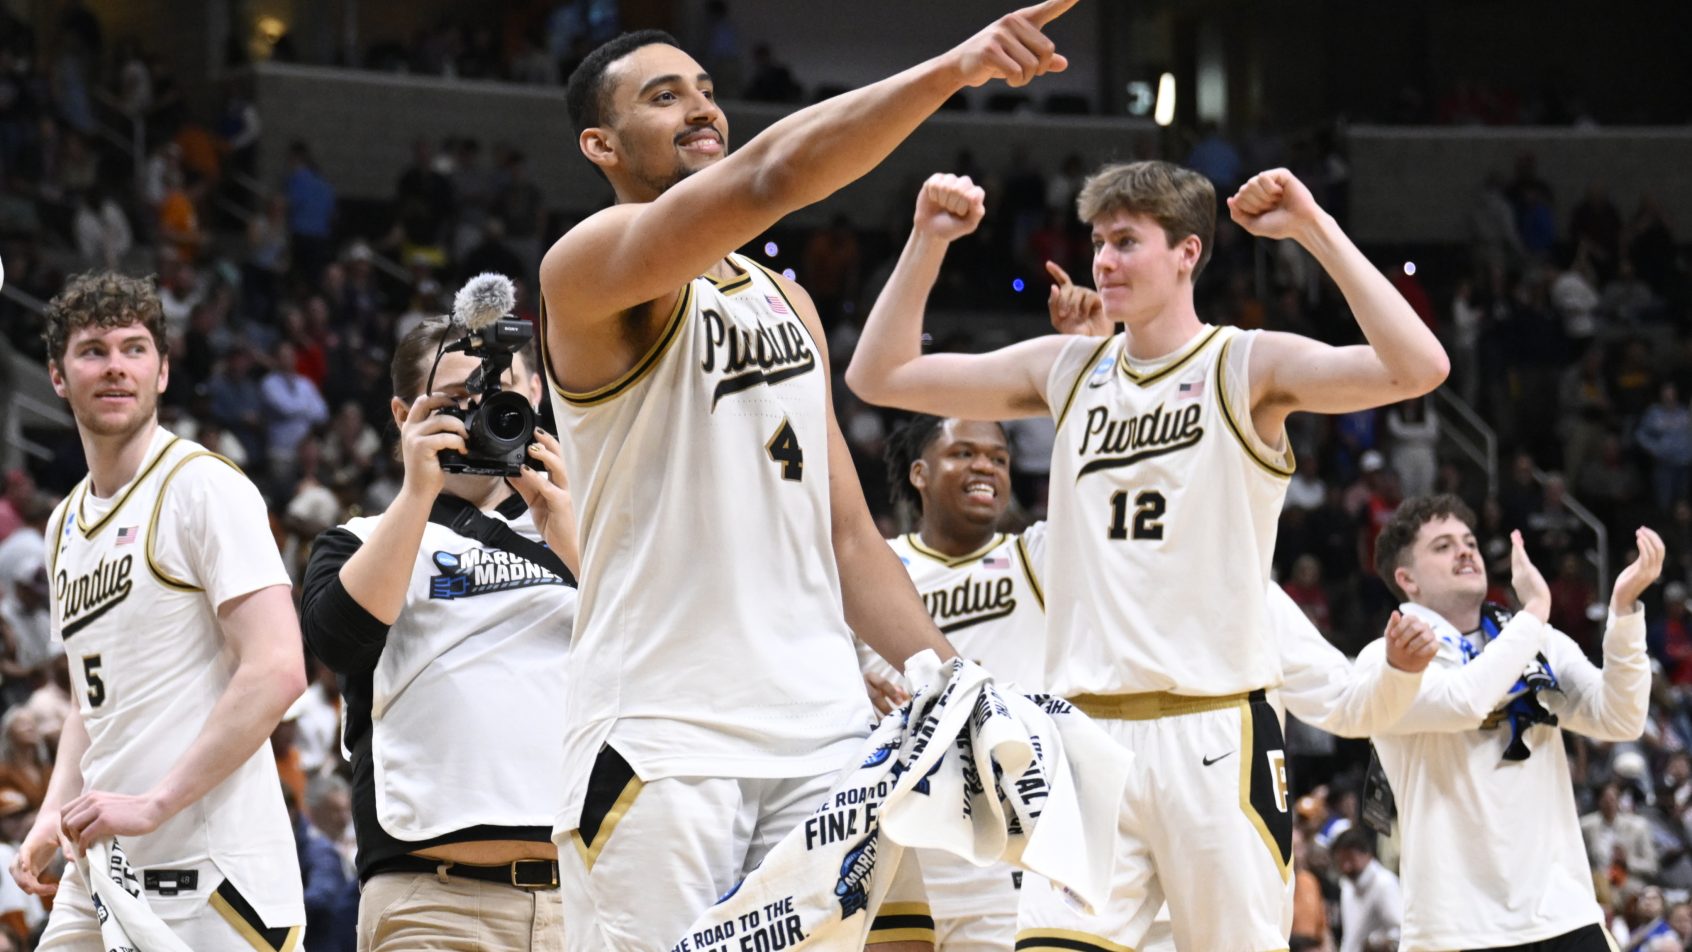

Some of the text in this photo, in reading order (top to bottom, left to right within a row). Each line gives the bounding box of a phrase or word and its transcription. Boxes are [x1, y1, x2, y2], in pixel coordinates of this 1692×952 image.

[701, 309, 815, 386] Pudue
[765, 415, 804, 482] 4
[1077, 402, 1204, 470] Purdue
[1108, 489, 1166, 541] 12
[460, 548, 531, 569] MARC
[474, 561, 563, 586] MADNE
[921, 573, 1016, 622] urdue
[81, 652, 106, 708] 5
[693, 920, 735, 950] ROAD
[738, 909, 760, 932] TO
[763, 896, 795, 922] THE
